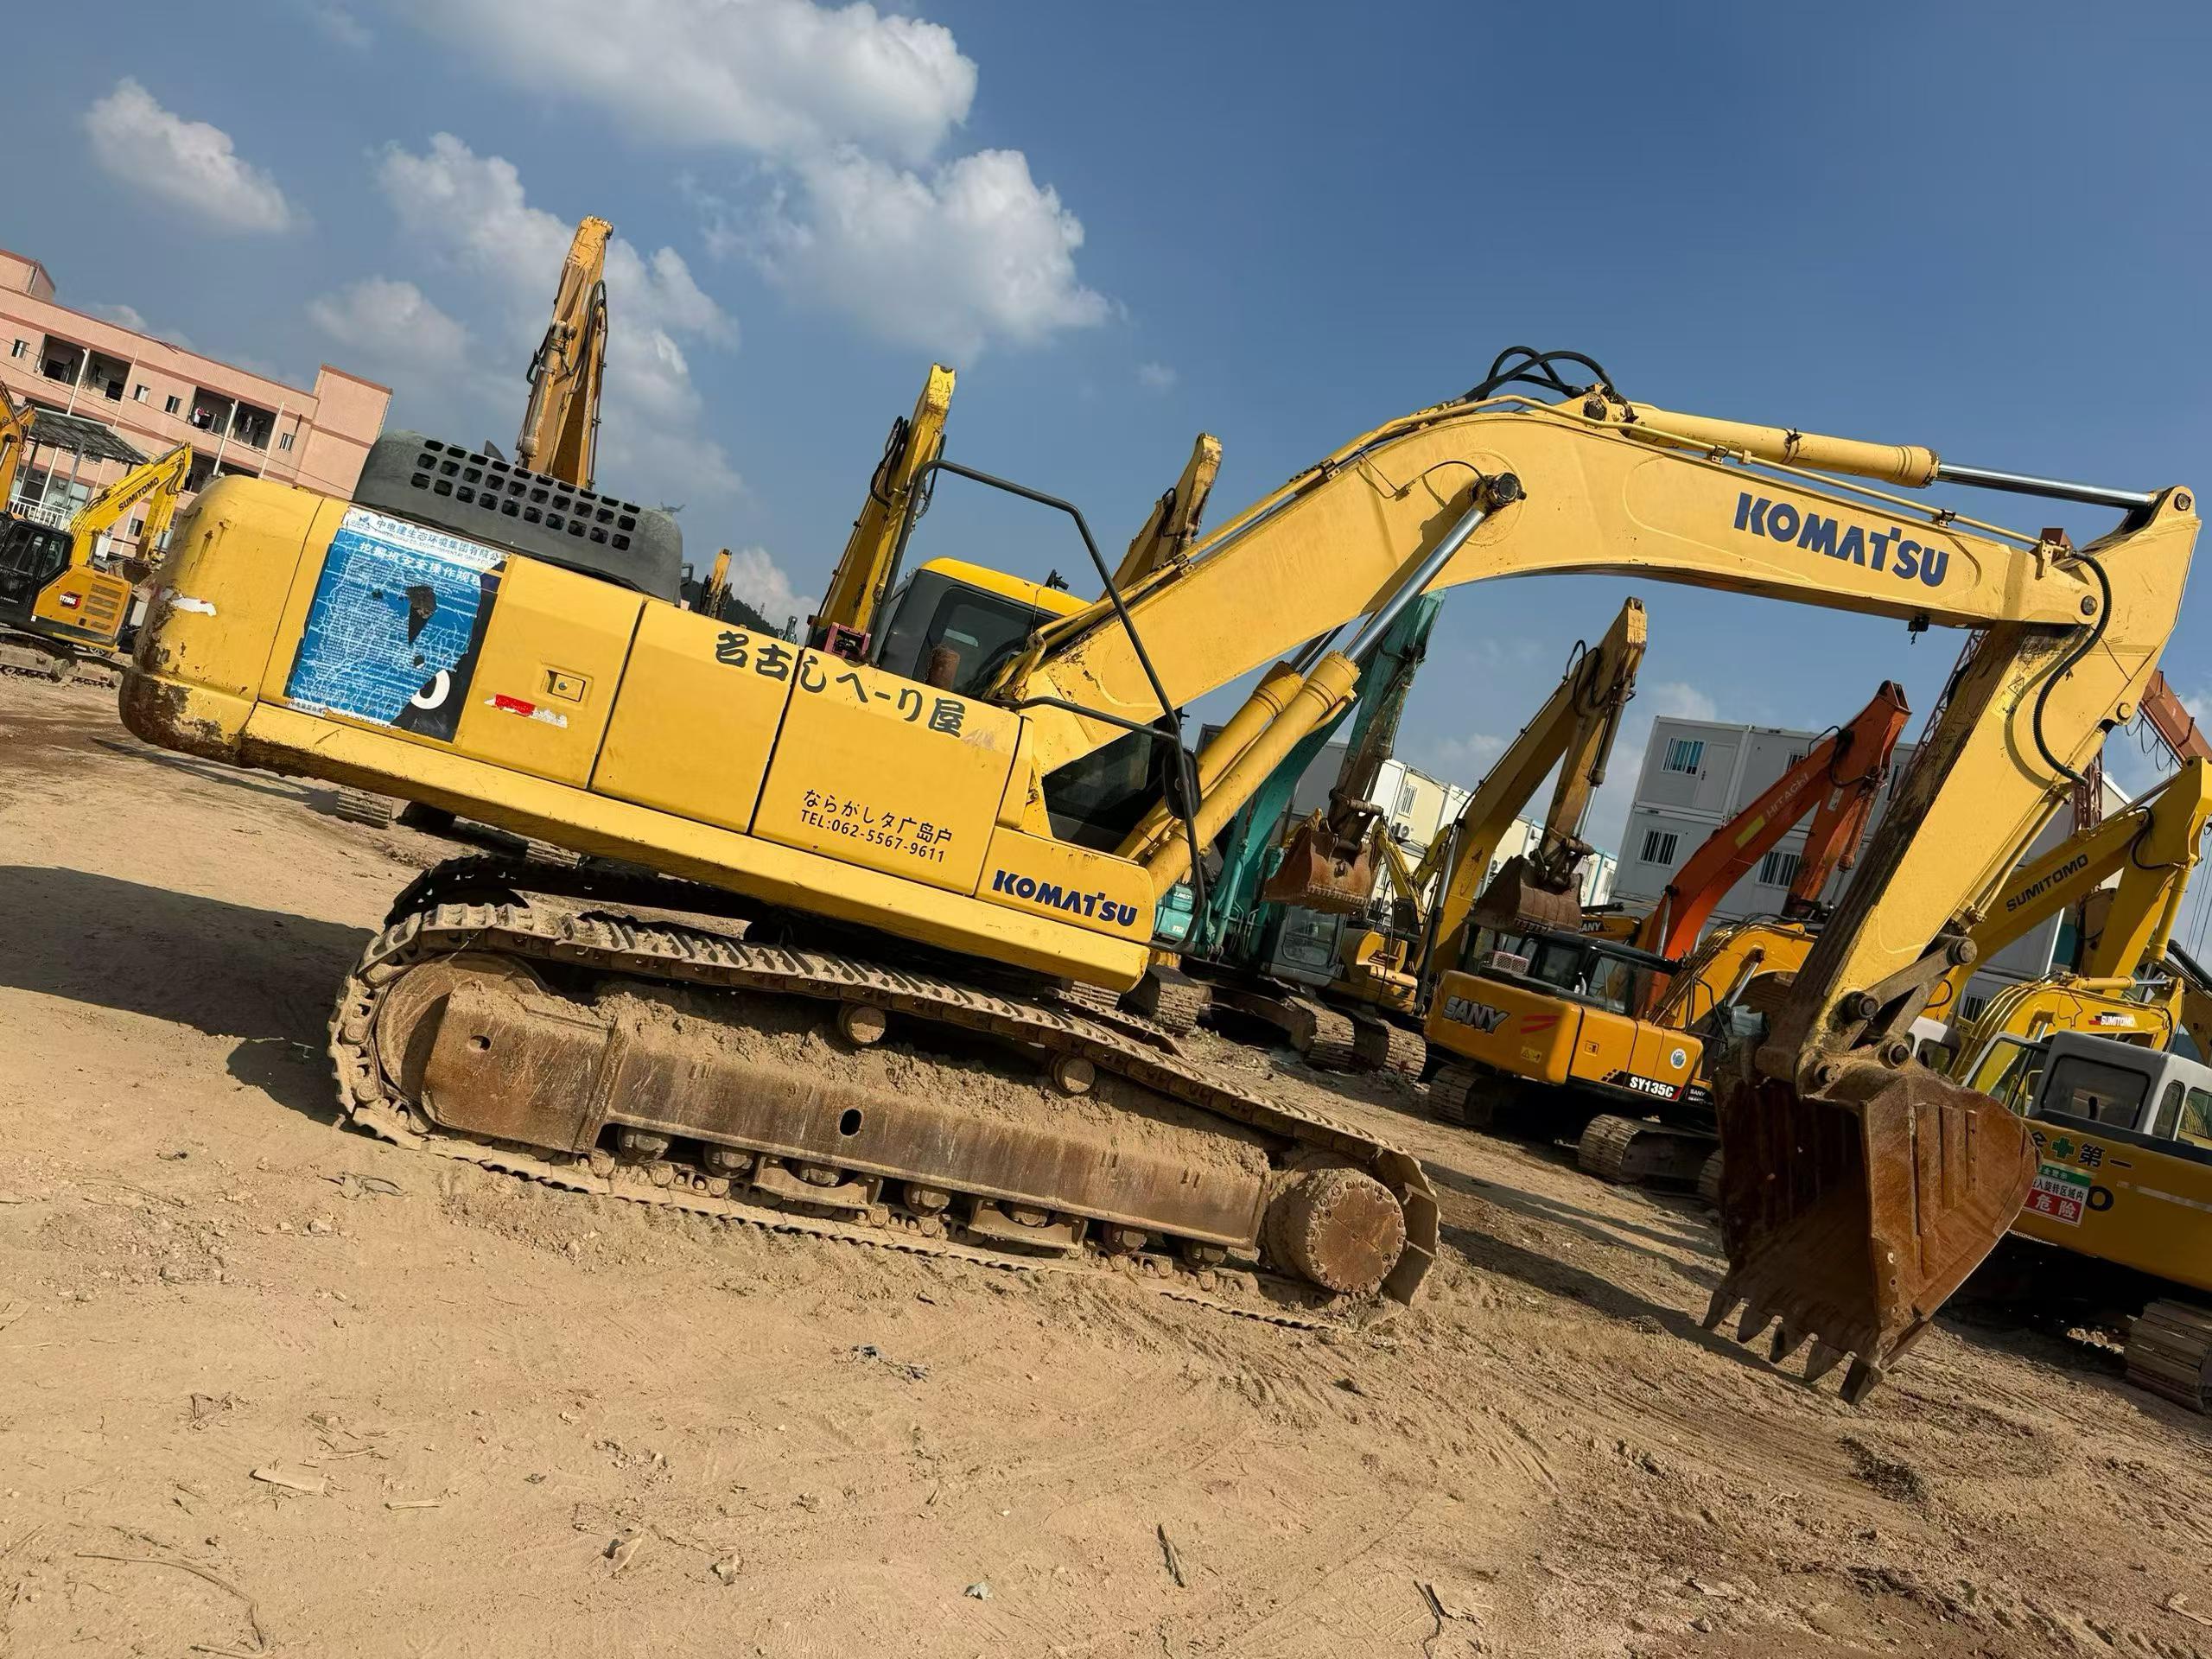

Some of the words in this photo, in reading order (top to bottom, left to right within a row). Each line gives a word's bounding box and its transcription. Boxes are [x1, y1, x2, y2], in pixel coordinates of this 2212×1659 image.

[118, 476, 160, 512] SUMITOMO
[1733, 492, 1949, 588] KOMATSU
[1766, 772, 1809, 818] HITACHI
[801, 809, 945, 863] TEL:062-5567-9611
[992, 869, 1138, 927] KOMATSU
[2005, 854, 2089, 912] SUMITOMO
[1442, 995, 1511, 1035] SANY
[2100, 1014, 2135, 1027] SUMITOMO
[1629, 1076, 1675, 1098] SY135C
[2077, 1142, 2133, 1169] 第一
[2034, 1193, 2076, 1219] 危险
